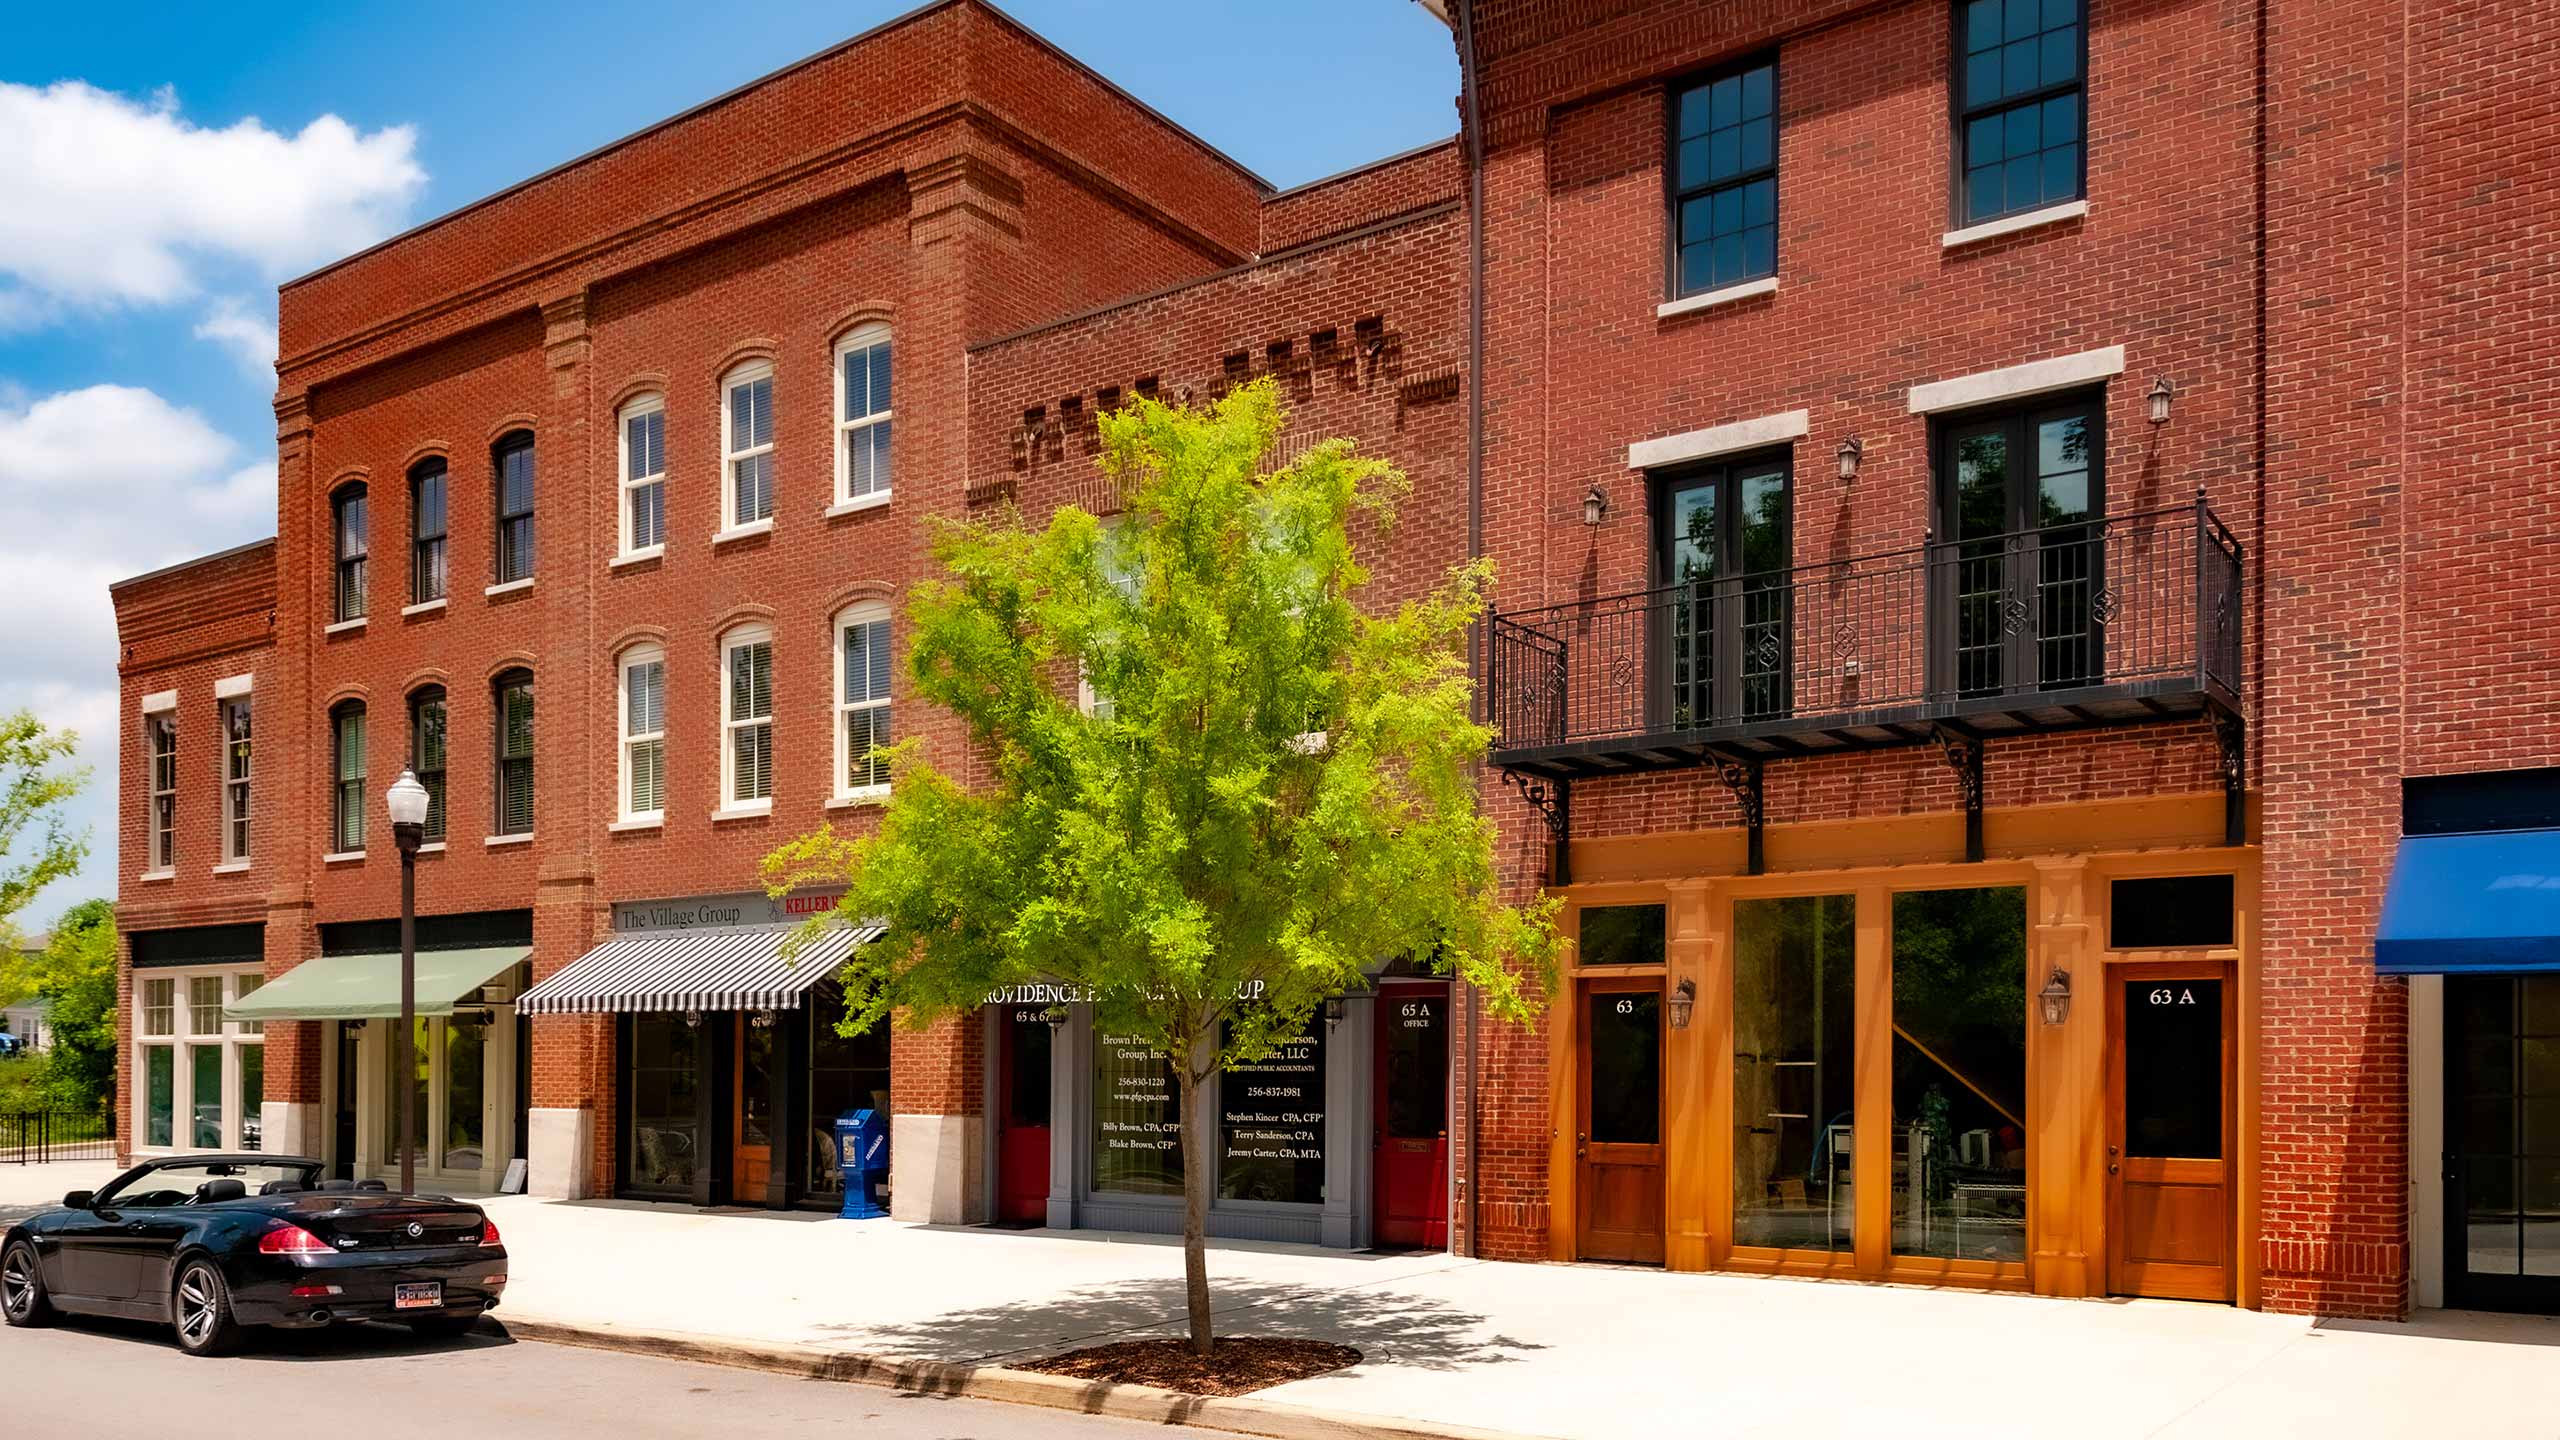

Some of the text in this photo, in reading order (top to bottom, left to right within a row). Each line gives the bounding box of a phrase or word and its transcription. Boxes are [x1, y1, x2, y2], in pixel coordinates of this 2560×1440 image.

[785, 895, 829, 913] KELLER
[622, 904, 740, 929] The Village Group
[982, 983, 1083, 1003] ROVIDENCE
[2149, 988, 2196, 1005] 63 A
[1402, 1004, 1430, 1016] 65 A
[1616, 999, 1633, 1014] 63
[752, 1017, 761, 1027] 67
[1016, 1010, 1028, 1023] 65
[1029, 1012, 1038, 1022] &
[1102, 1033, 1131, 1046] Brown
[1117, 1047, 1168, 1062] Group, Inc.
[1286, 1046, 1310, 1060] LLC
[1247, 1086, 1301, 1098] 256-837-1981
[1226, 1112, 1254, 1124] Stephen
[1255, 1112, 1280, 1122] Kincer
[1282, 1112, 1303, 1123] CPA,
[1103, 1121, 1181, 1133] Billy Brown, CPA, CFP
[1233, 1129, 1315, 1141] Terry Sanderson, CPA
[1109, 1138, 1129, 1149] Blake
[1130, 1139, 1156, 1150] Brown,
[1227, 1147, 1322, 1159] Jeremy Carter, CPA, MTA
